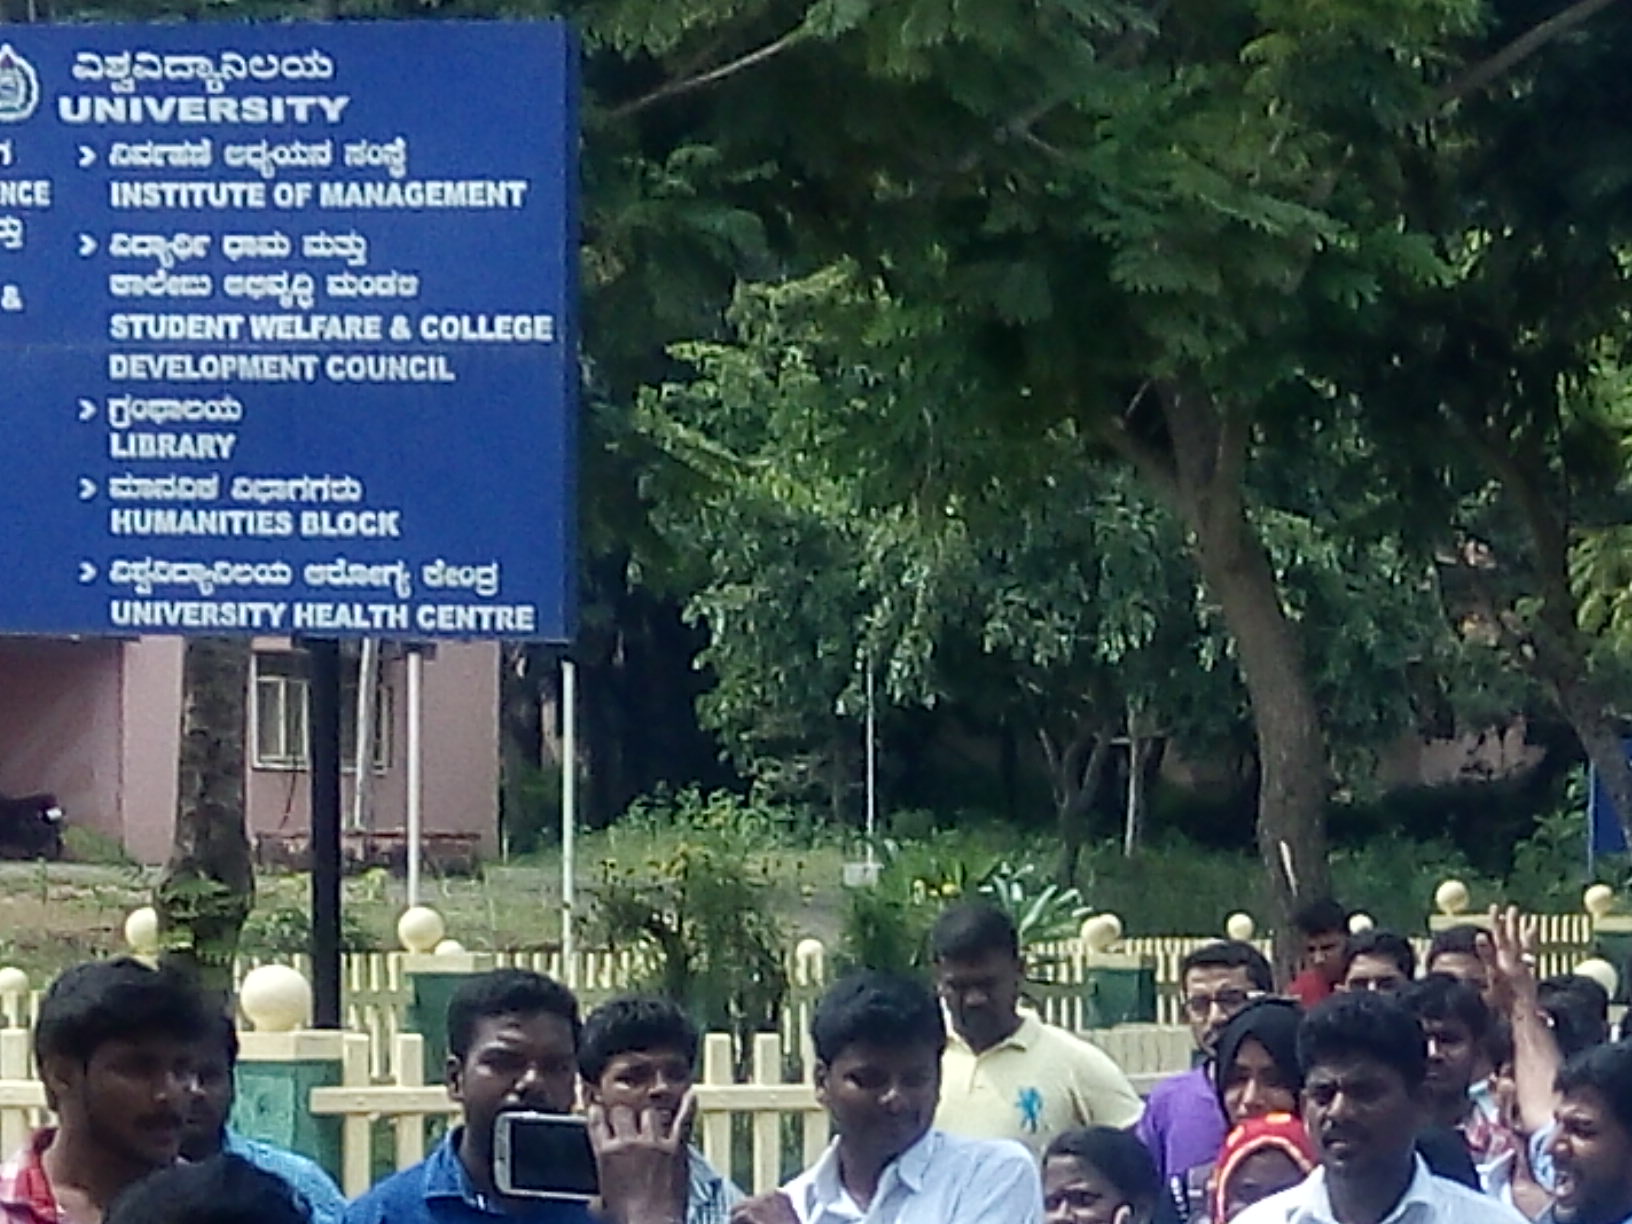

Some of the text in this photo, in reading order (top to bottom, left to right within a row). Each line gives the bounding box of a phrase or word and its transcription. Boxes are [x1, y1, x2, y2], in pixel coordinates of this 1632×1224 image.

[58, 95, 351, 125] UNIVERSITY
[110, 182, 528, 208] INSTITUTE OF MANAGEMENT
[110, 314, 554, 342] STUDENT WELFARE & COLLEGE
[109, 354, 455, 381] DEVELOPMENT COUNCIL
[110, 433, 236, 459] LIBRARY
[110, 510, 400, 536] HUMANITIES BLOCK
[110, 600, 536, 632] UNIVERSITY HEALTH CENTRE
